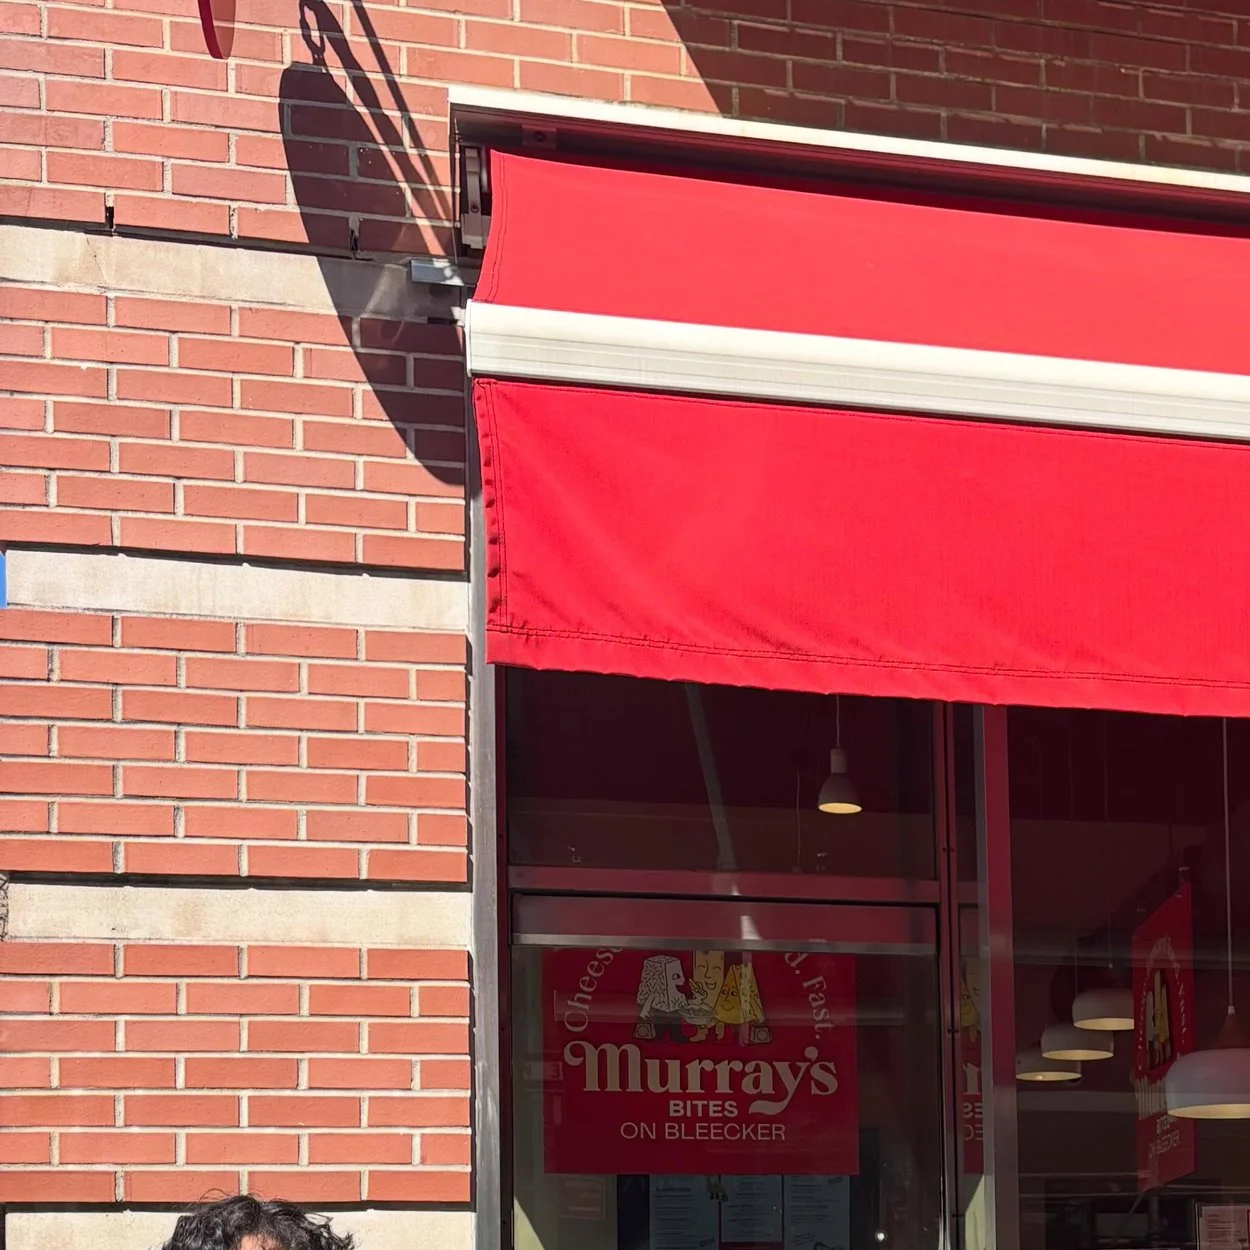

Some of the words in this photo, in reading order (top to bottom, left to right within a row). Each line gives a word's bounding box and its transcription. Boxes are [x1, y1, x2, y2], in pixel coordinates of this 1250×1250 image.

[565, 948, 623, 1032] Chees
[803, 976, 834, 1040] Fast.
[564, 1040, 839, 1116] Murray's
[620, 1122, 656, 1140] ON
[664, 1122, 785, 1141] BLEECKER
[669, 1100, 738, 1117] BITES
